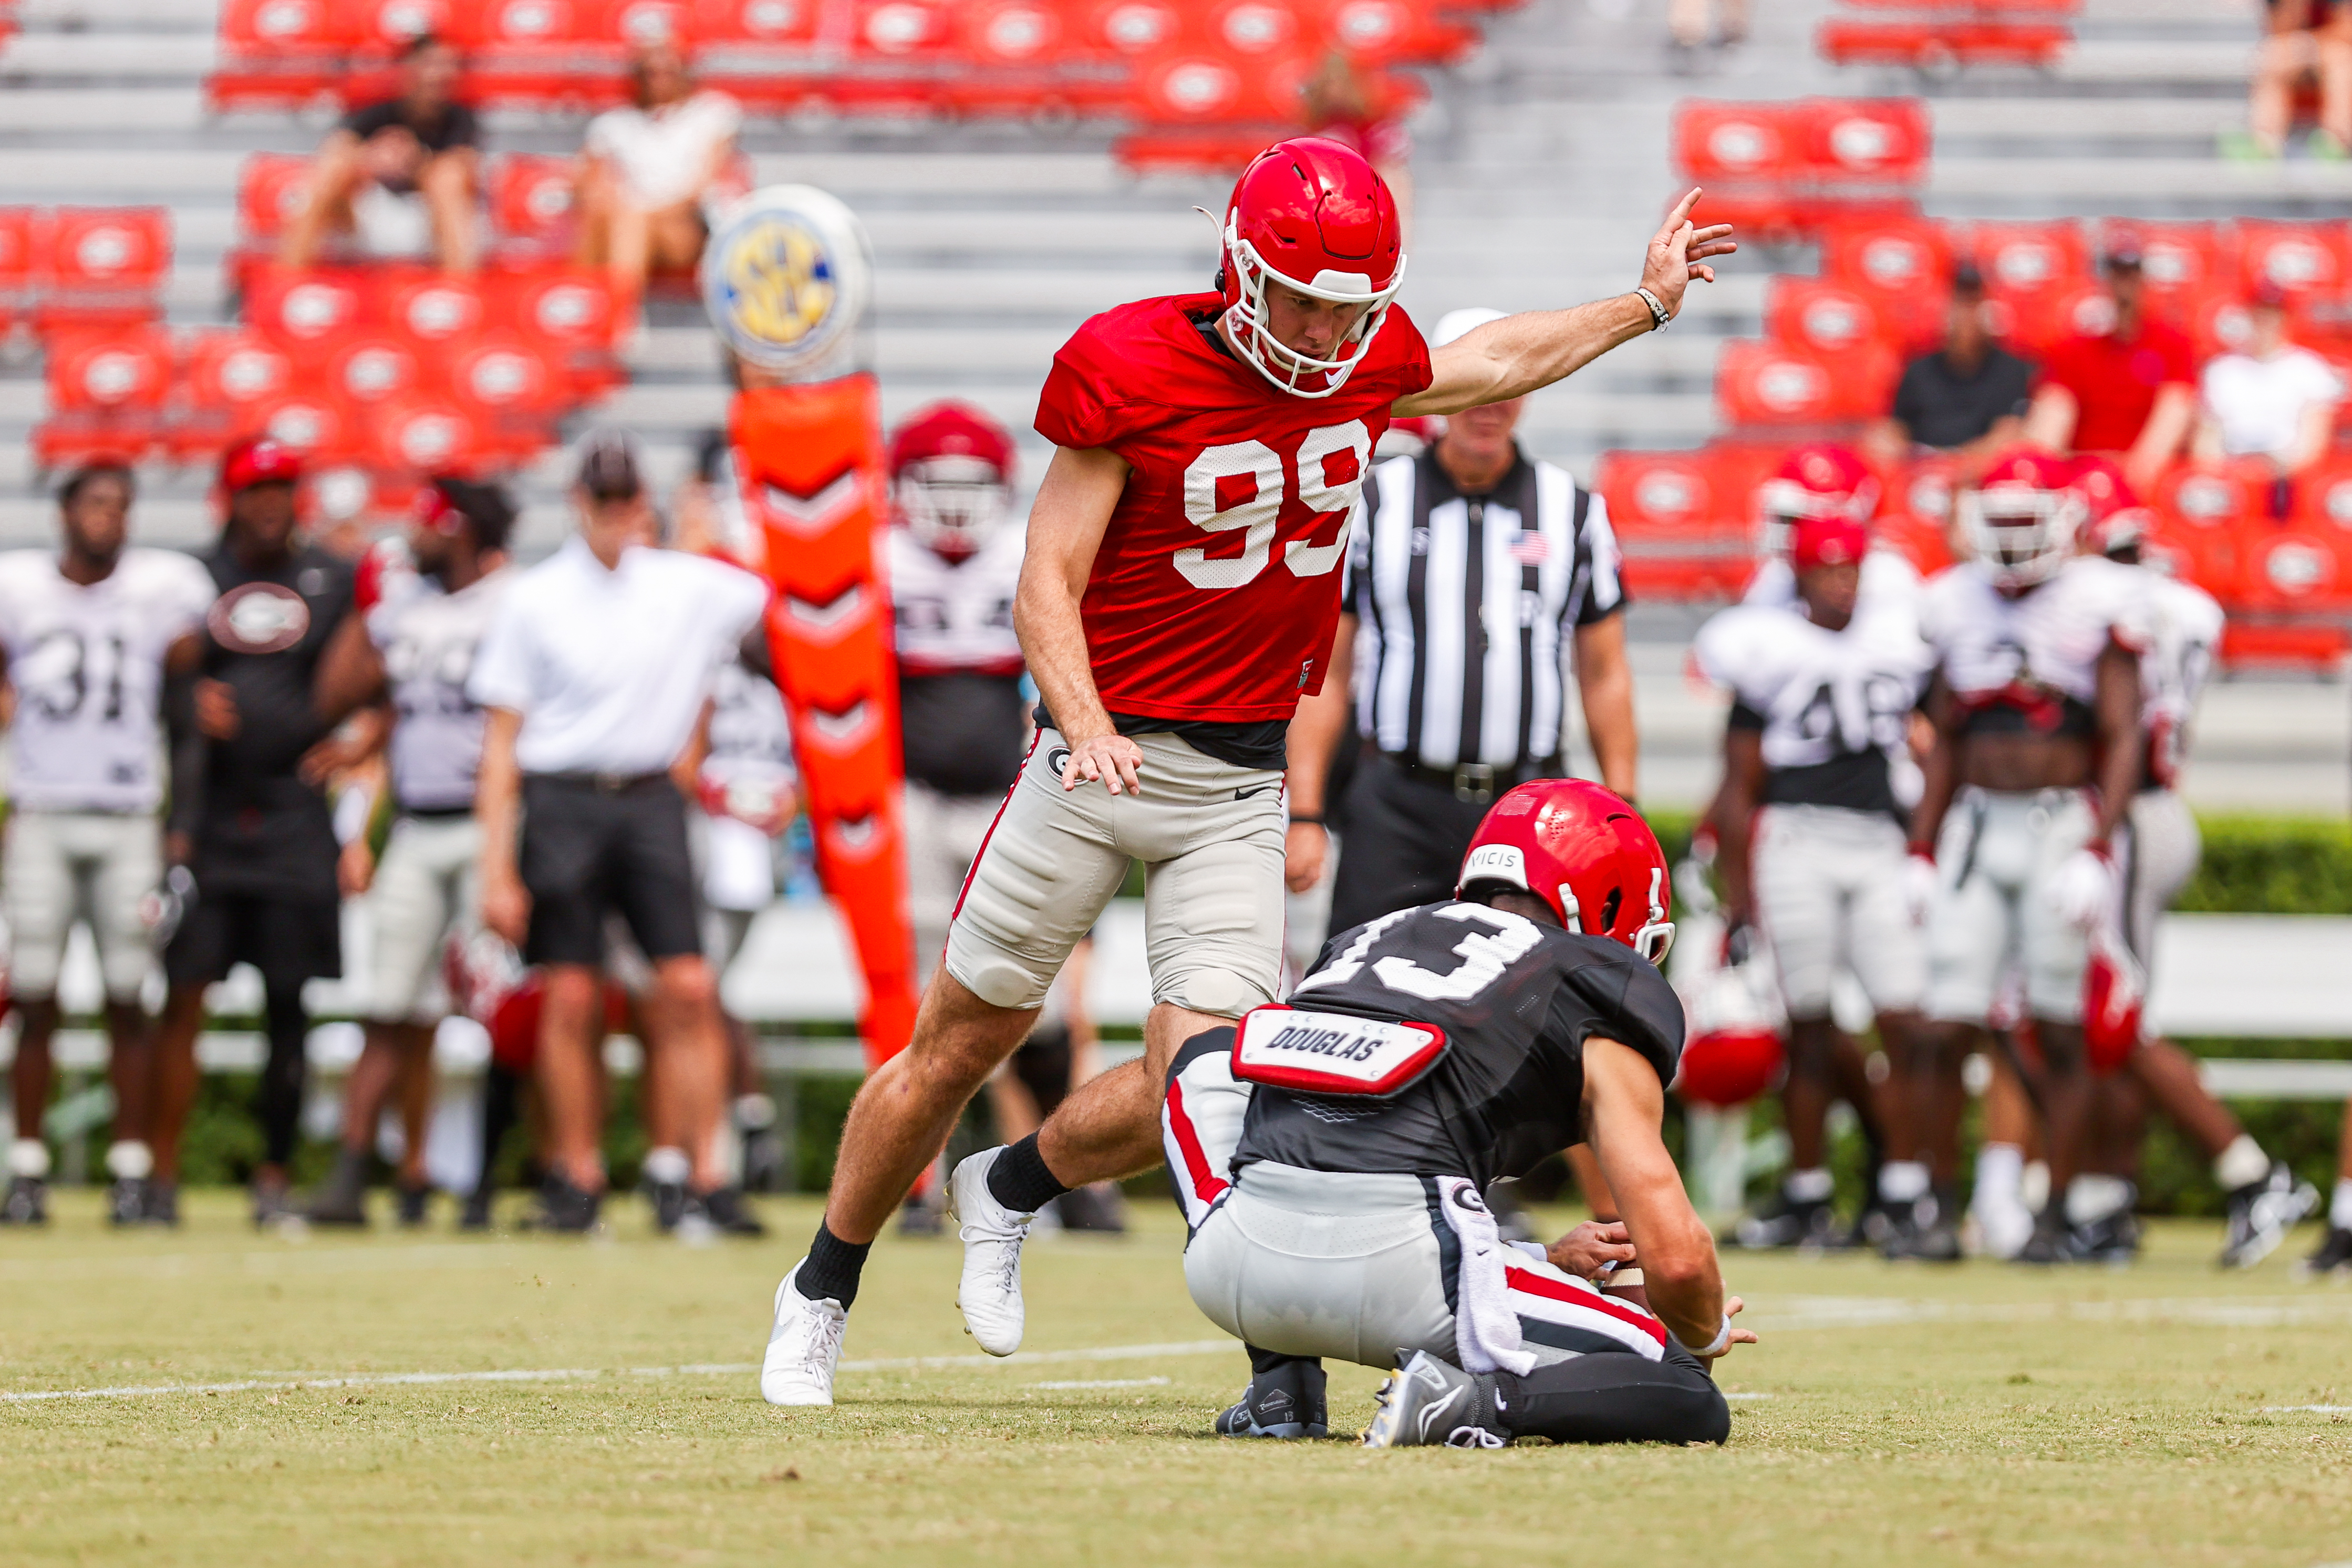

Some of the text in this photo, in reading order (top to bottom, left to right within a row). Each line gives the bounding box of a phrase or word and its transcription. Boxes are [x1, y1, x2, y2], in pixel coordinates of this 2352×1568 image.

[1173, 418, 1372, 588] 99
[30, 630, 123, 721] 31
[1472, 852, 1517, 867] VICIS
[1294, 902, 1545, 1001] 13
[1265, 1025, 1384, 1061] DOUGLAS
